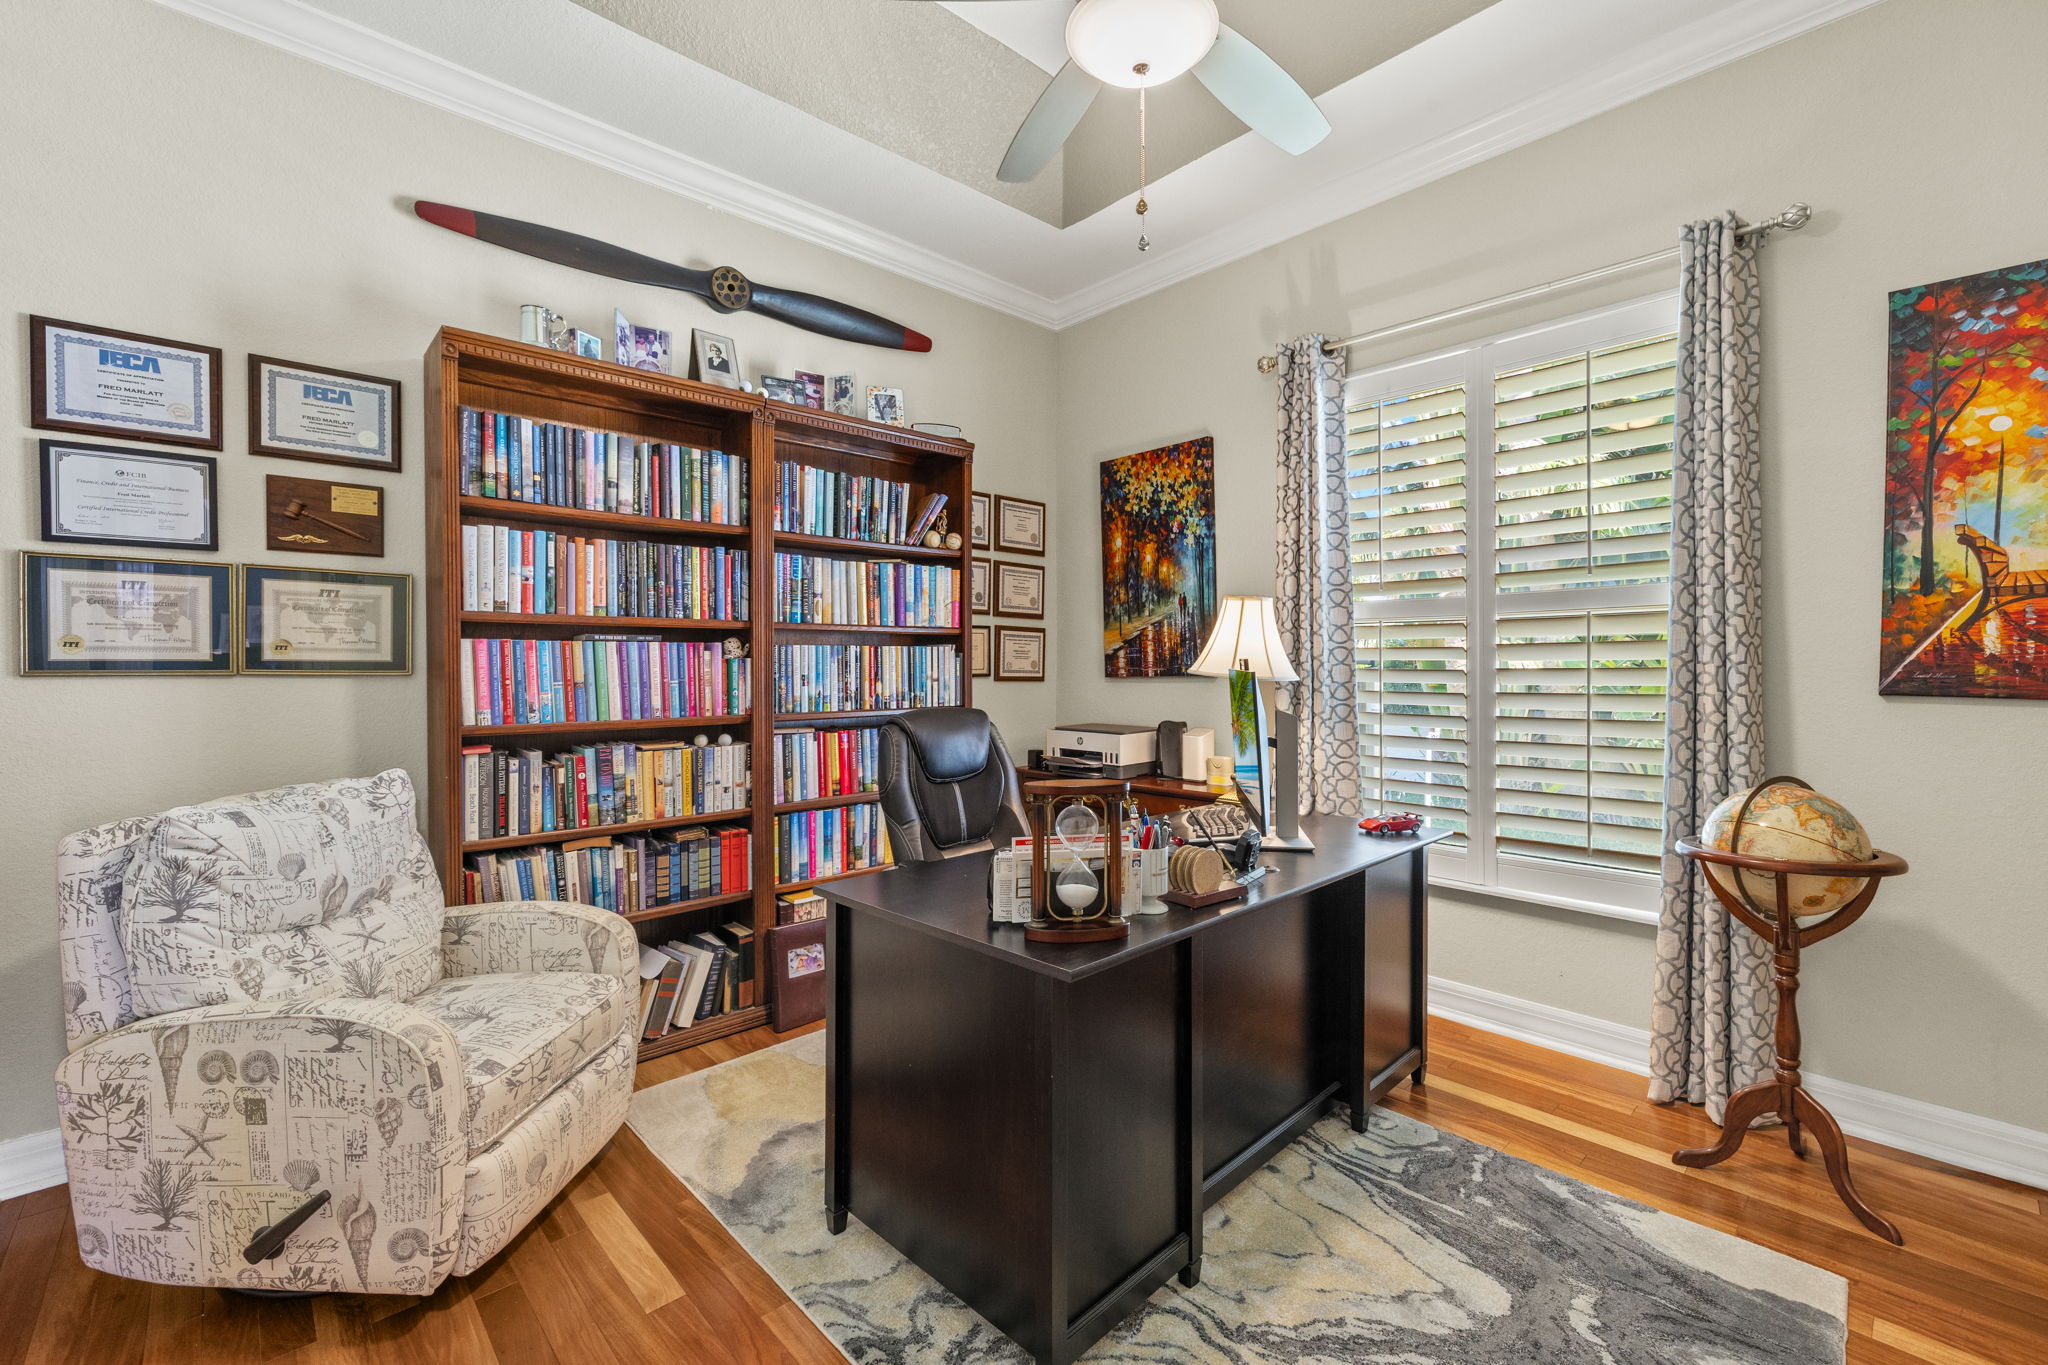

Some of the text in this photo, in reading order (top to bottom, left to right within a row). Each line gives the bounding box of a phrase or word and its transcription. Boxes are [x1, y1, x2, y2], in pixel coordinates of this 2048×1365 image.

[98, 384, 164, 397] FRED MARLATT
[320, 589, 340, 598] ITI
[600, 748, 613, 787] PAT CONROY
